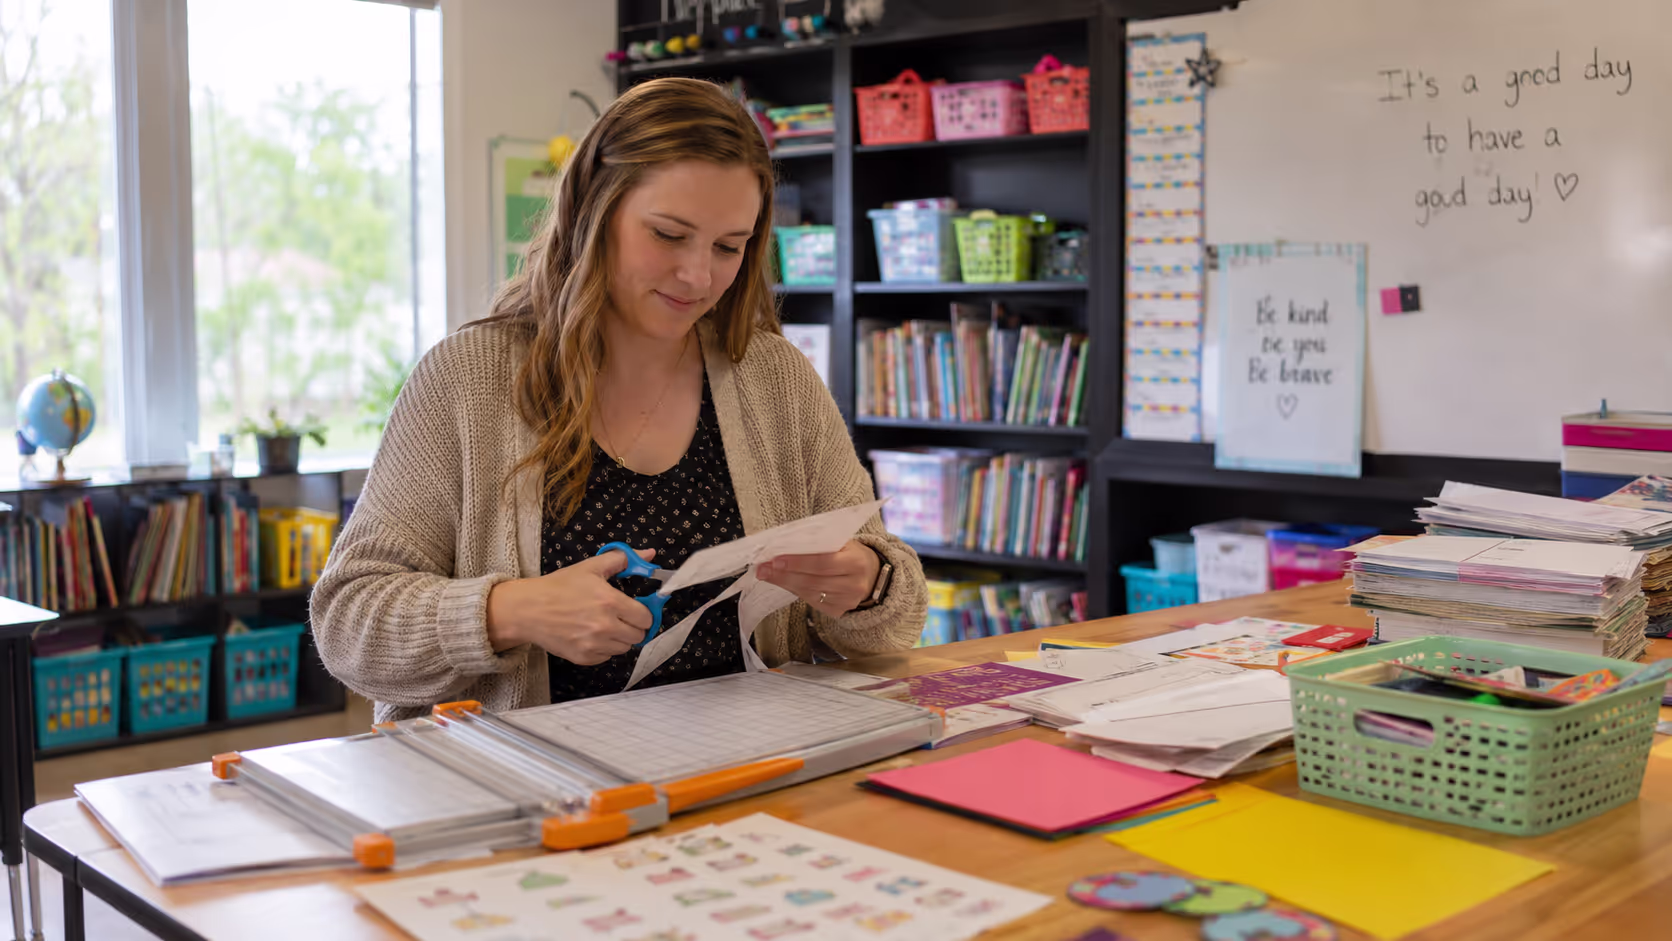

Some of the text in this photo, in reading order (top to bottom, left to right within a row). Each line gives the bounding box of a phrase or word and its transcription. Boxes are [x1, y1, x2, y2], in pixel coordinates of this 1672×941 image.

[1377, 69, 1440, 102] It's
[1462, 74, 1480, 94] a
[1584, 47, 1633, 96] day
[1423, 117, 1562, 154] to have a
[1256, 295, 1330, 325] Be kind
[1292, 336, 1327, 365] you
[1248, 357, 1334, 385] Be brave
